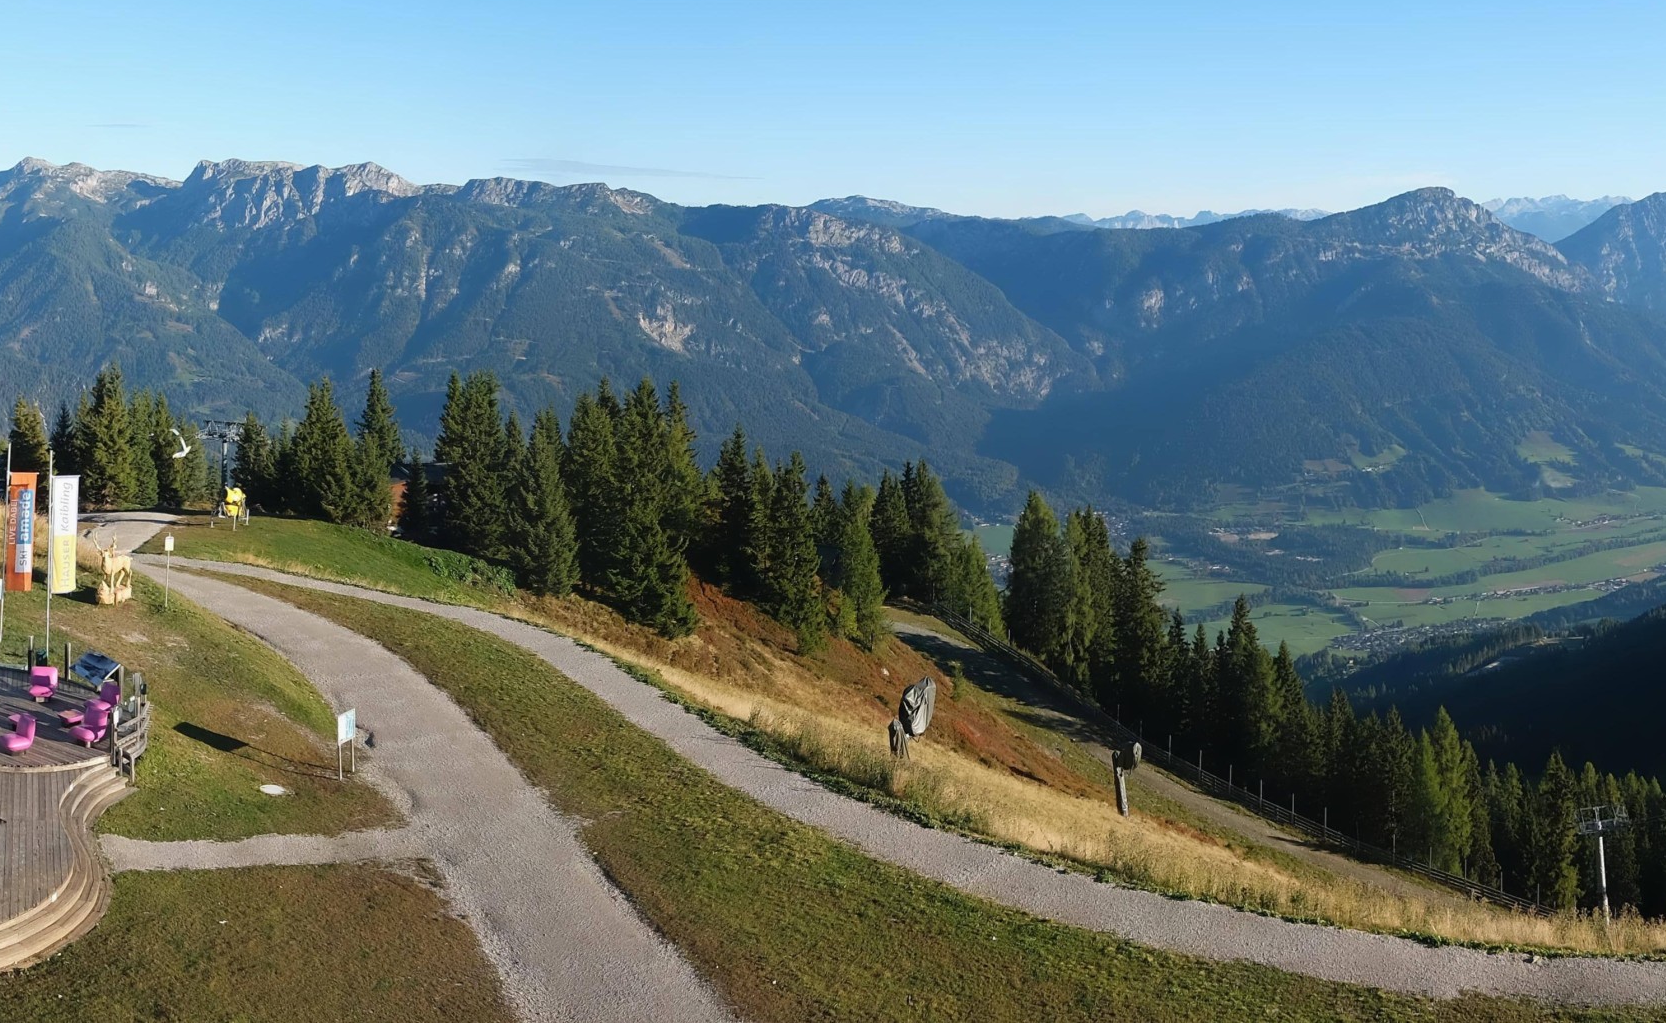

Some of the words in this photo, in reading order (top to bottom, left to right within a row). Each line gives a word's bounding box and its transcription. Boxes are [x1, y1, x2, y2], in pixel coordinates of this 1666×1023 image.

[60, 482, 74, 532] Kaibling
[19, 550, 27, 566] Ski
[61, 540, 70, 587] HAUSER
